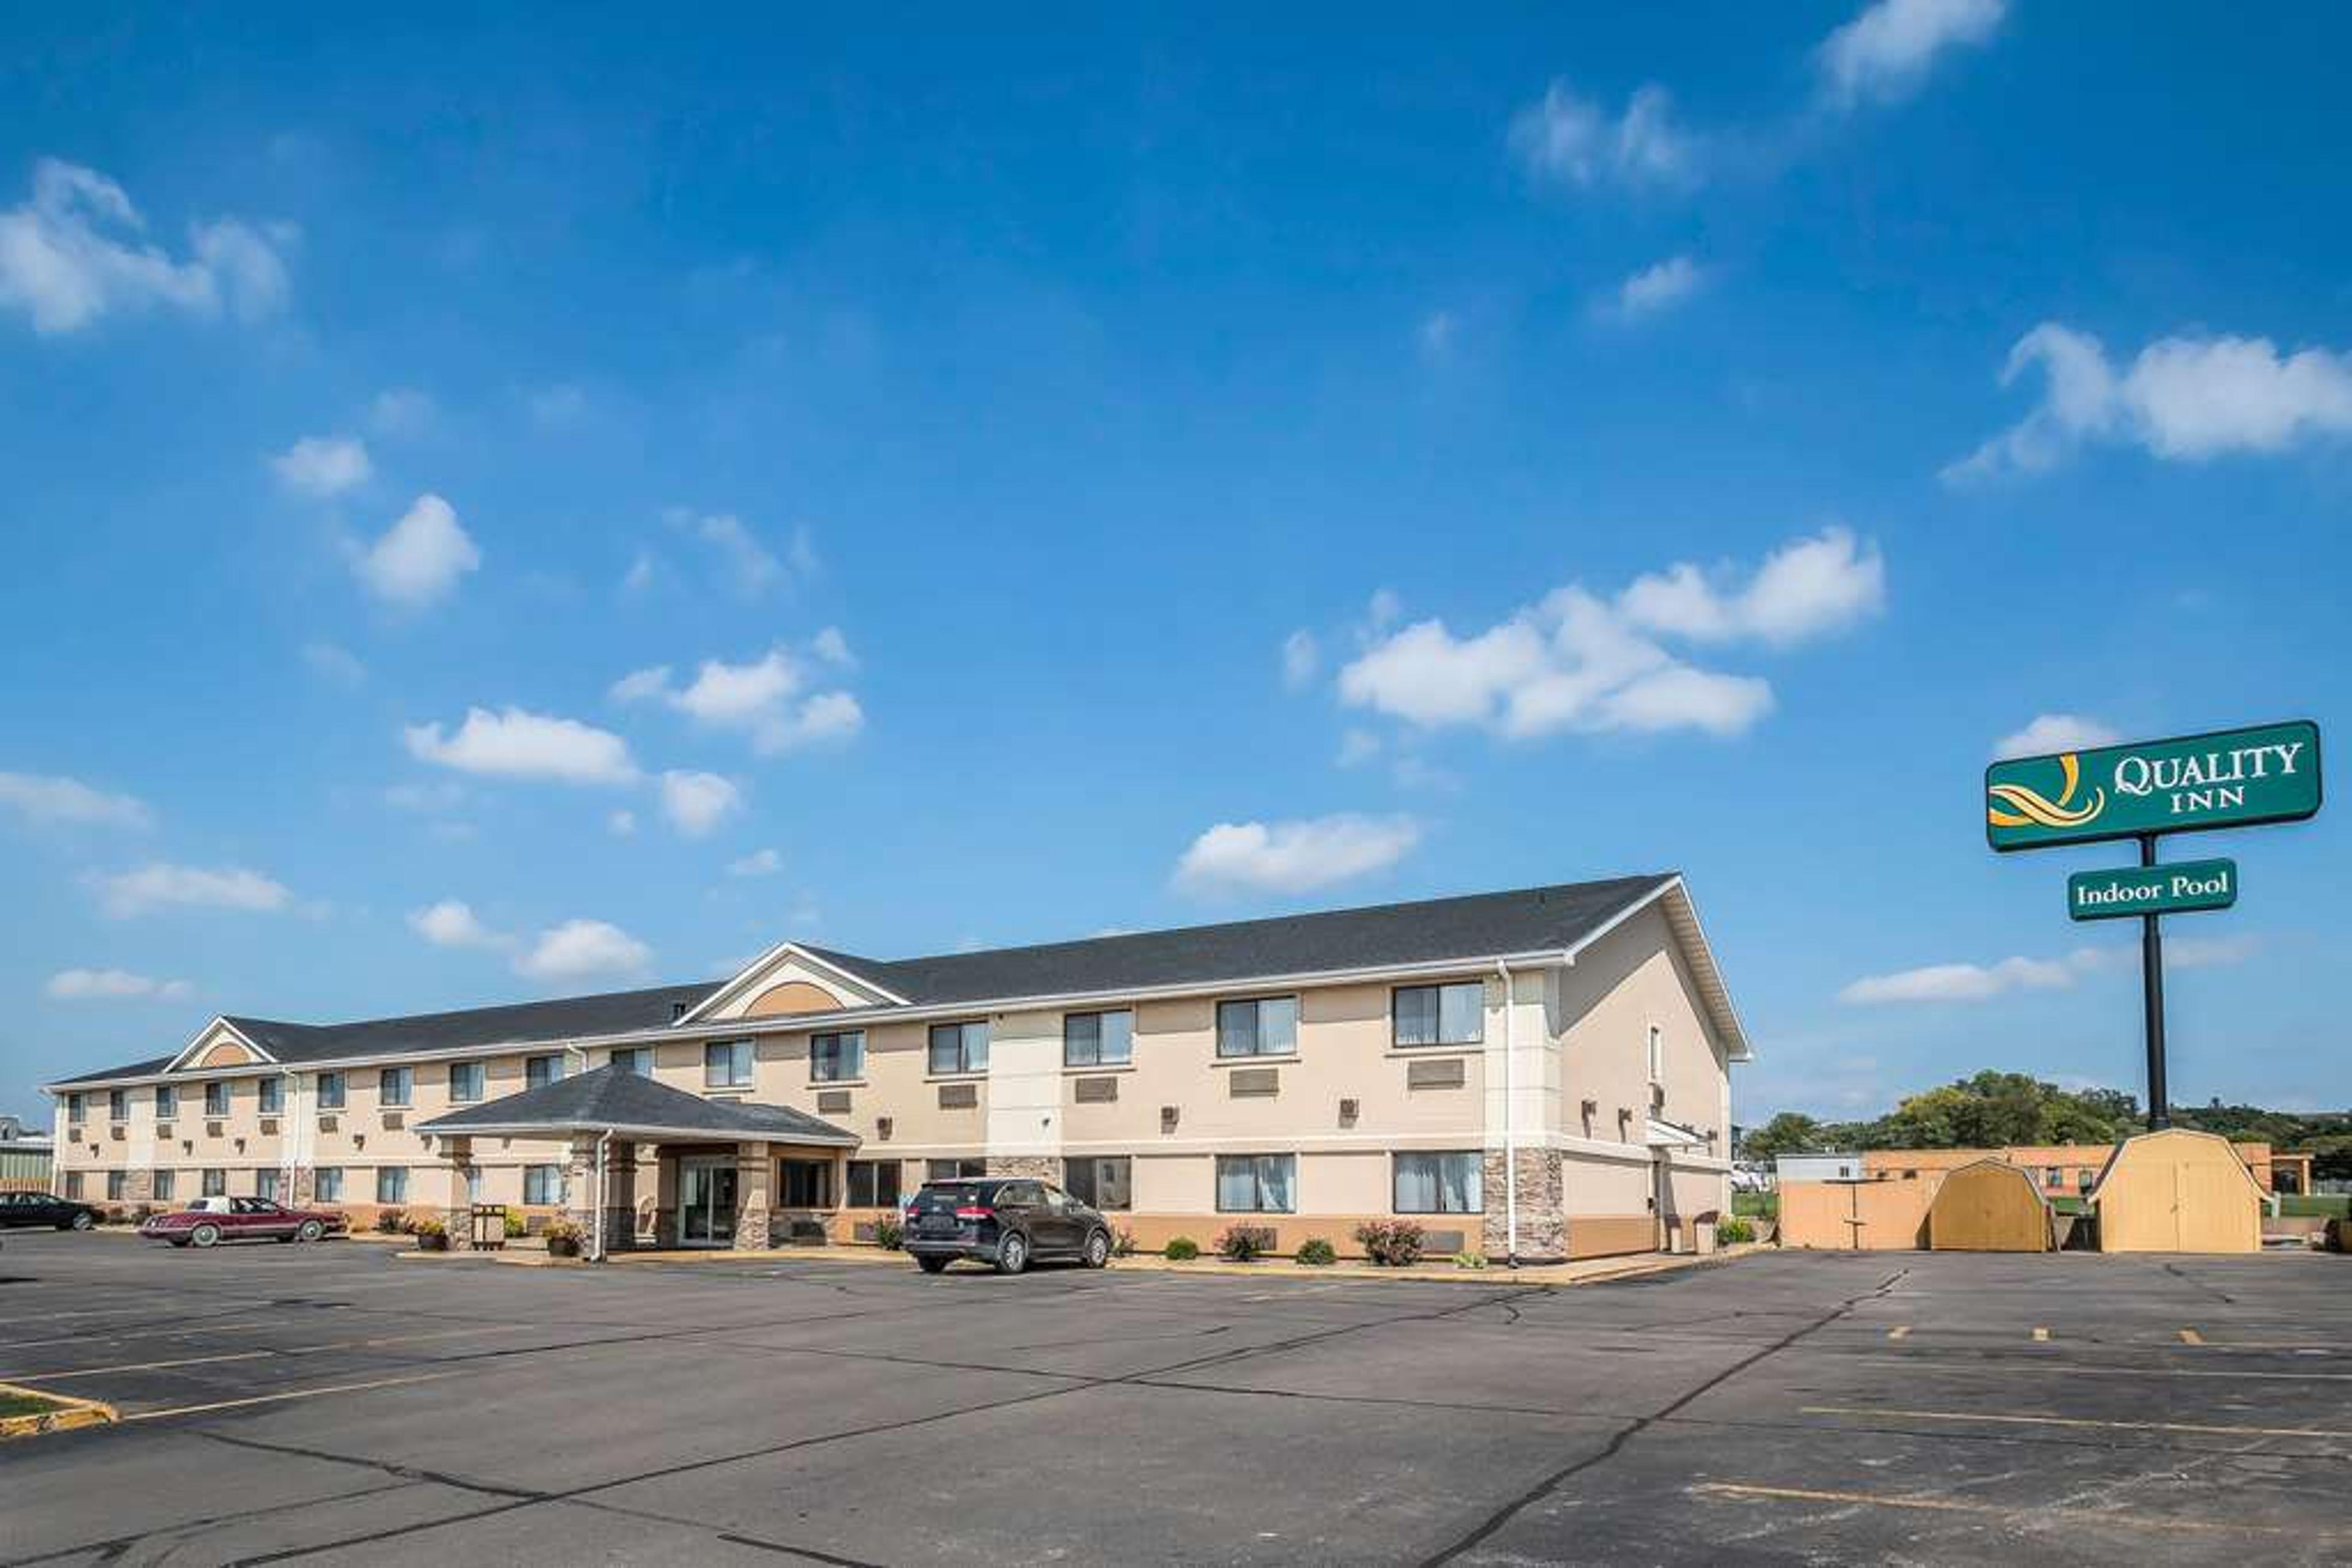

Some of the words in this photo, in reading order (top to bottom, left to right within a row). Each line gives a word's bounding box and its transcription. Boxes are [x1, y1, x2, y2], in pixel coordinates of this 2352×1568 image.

[2114, 742, 2303, 796] QUALITY
[2171, 785, 2245, 813] INN
[2078, 883, 2163, 905] Indoor
[2171, 871, 2228, 897] Pool
